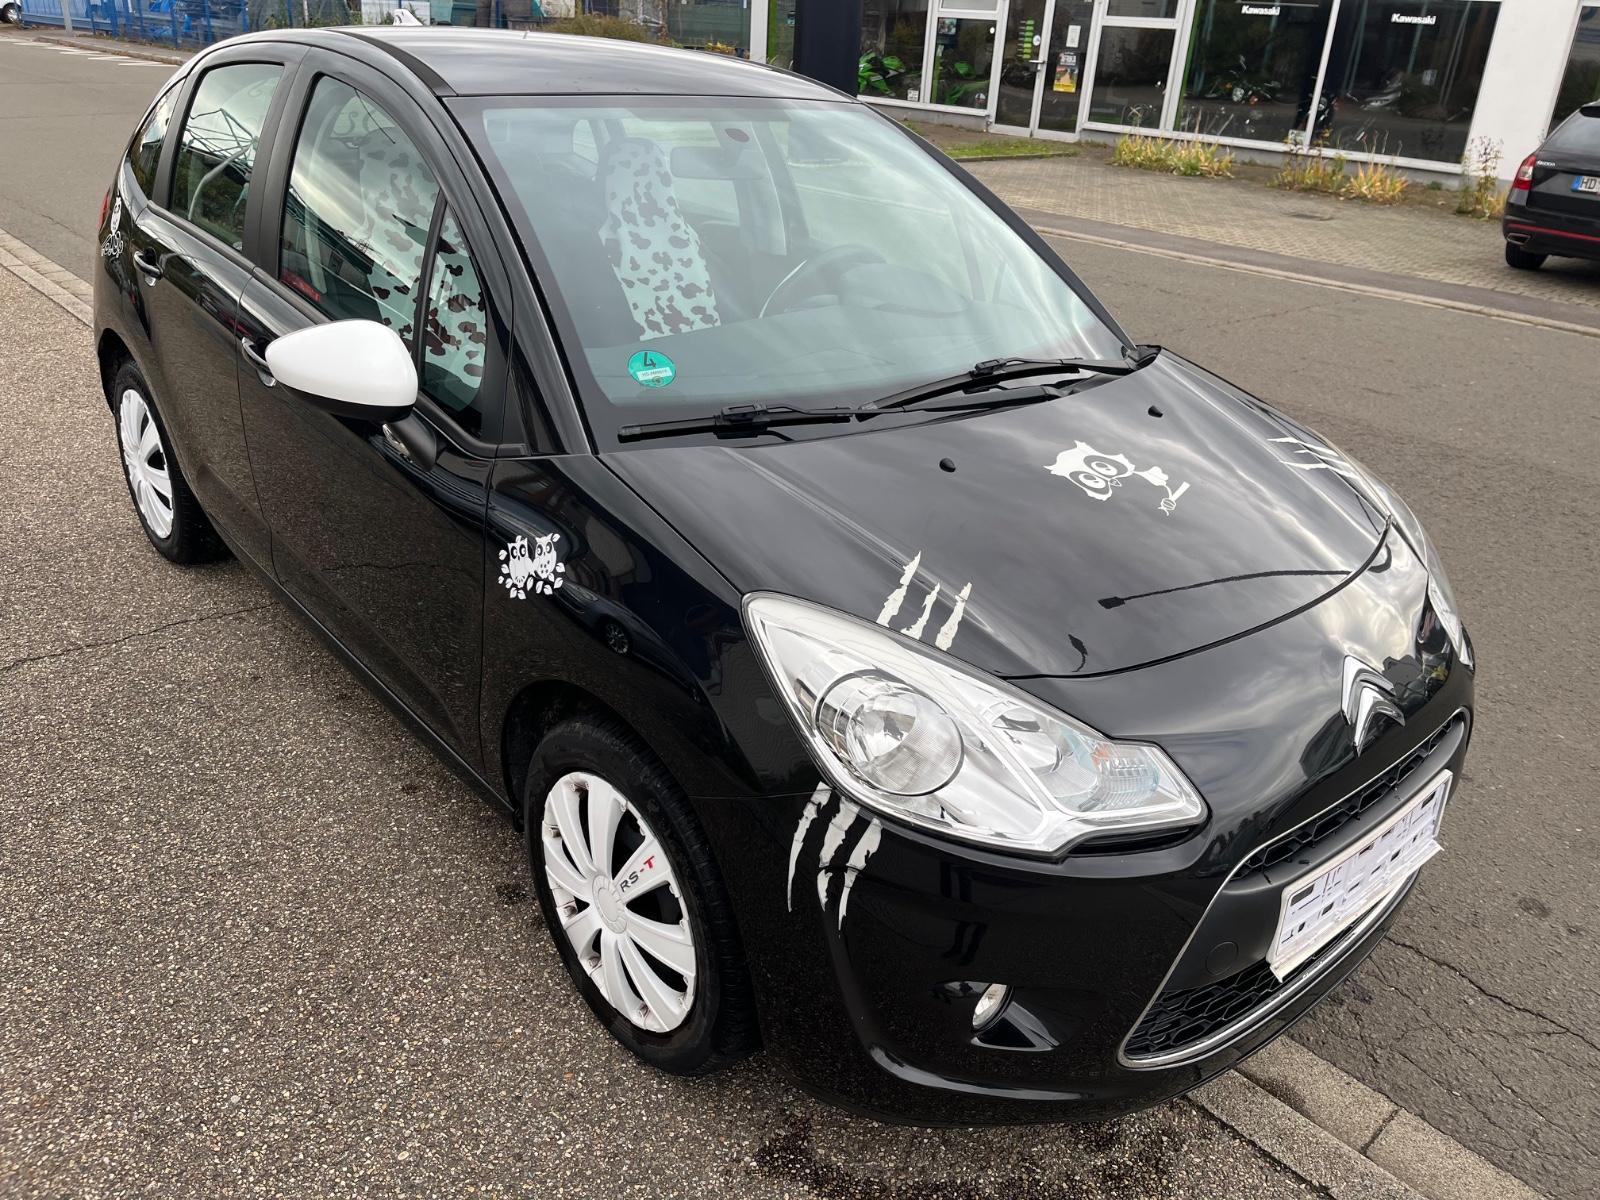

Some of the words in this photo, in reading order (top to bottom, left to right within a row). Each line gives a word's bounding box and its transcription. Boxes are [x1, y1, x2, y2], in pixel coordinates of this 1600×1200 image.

[1241, 4, 1281, 16] Kawasaki
[1391, 13, 1437, 25] Kawasaki
[1580, 178, 1598, 190] HD
[643, 351, 657, 368] 4
[620, 855, 655, 893] RS-T
